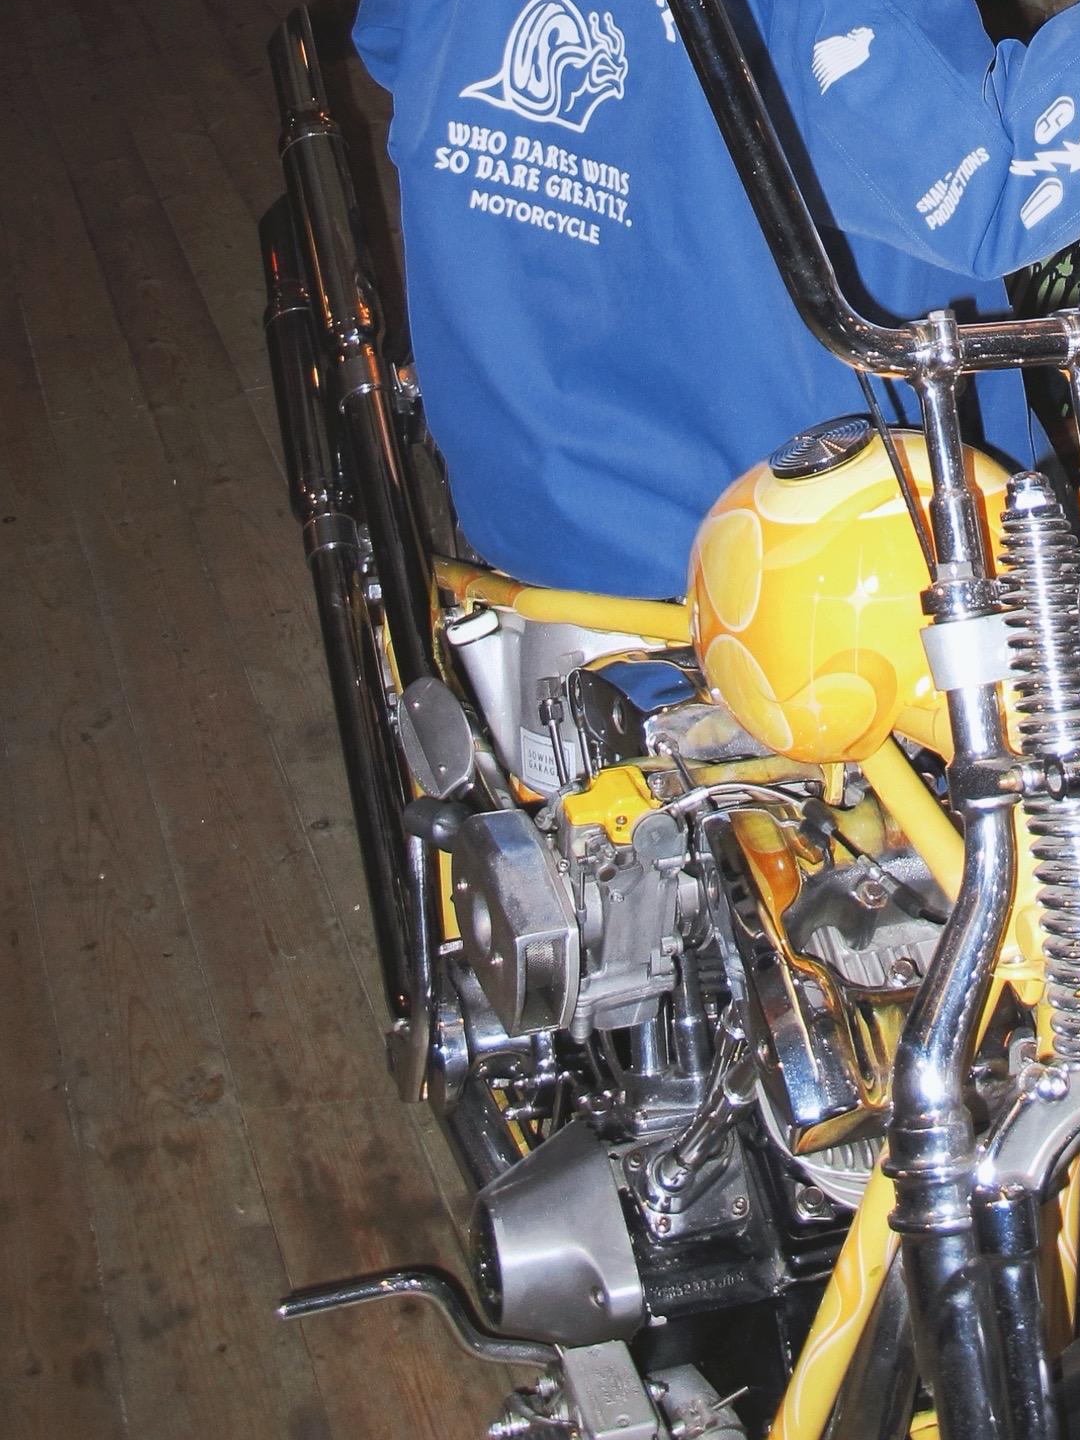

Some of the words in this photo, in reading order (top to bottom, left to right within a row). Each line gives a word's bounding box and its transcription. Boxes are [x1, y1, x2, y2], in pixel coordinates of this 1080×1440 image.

[435, 146, 470, 174] SO
[474, 154, 540, 193] DARE
[544, 176, 633, 228] GREATLY.
[447, 121, 507, 156] WHO
[511, 135, 579, 177] DARES
[581, 157, 631, 196] WINS
[925, 147, 990, 230] PRODUCTIONS
[469, 189, 600, 245] MOTORCYCLE
